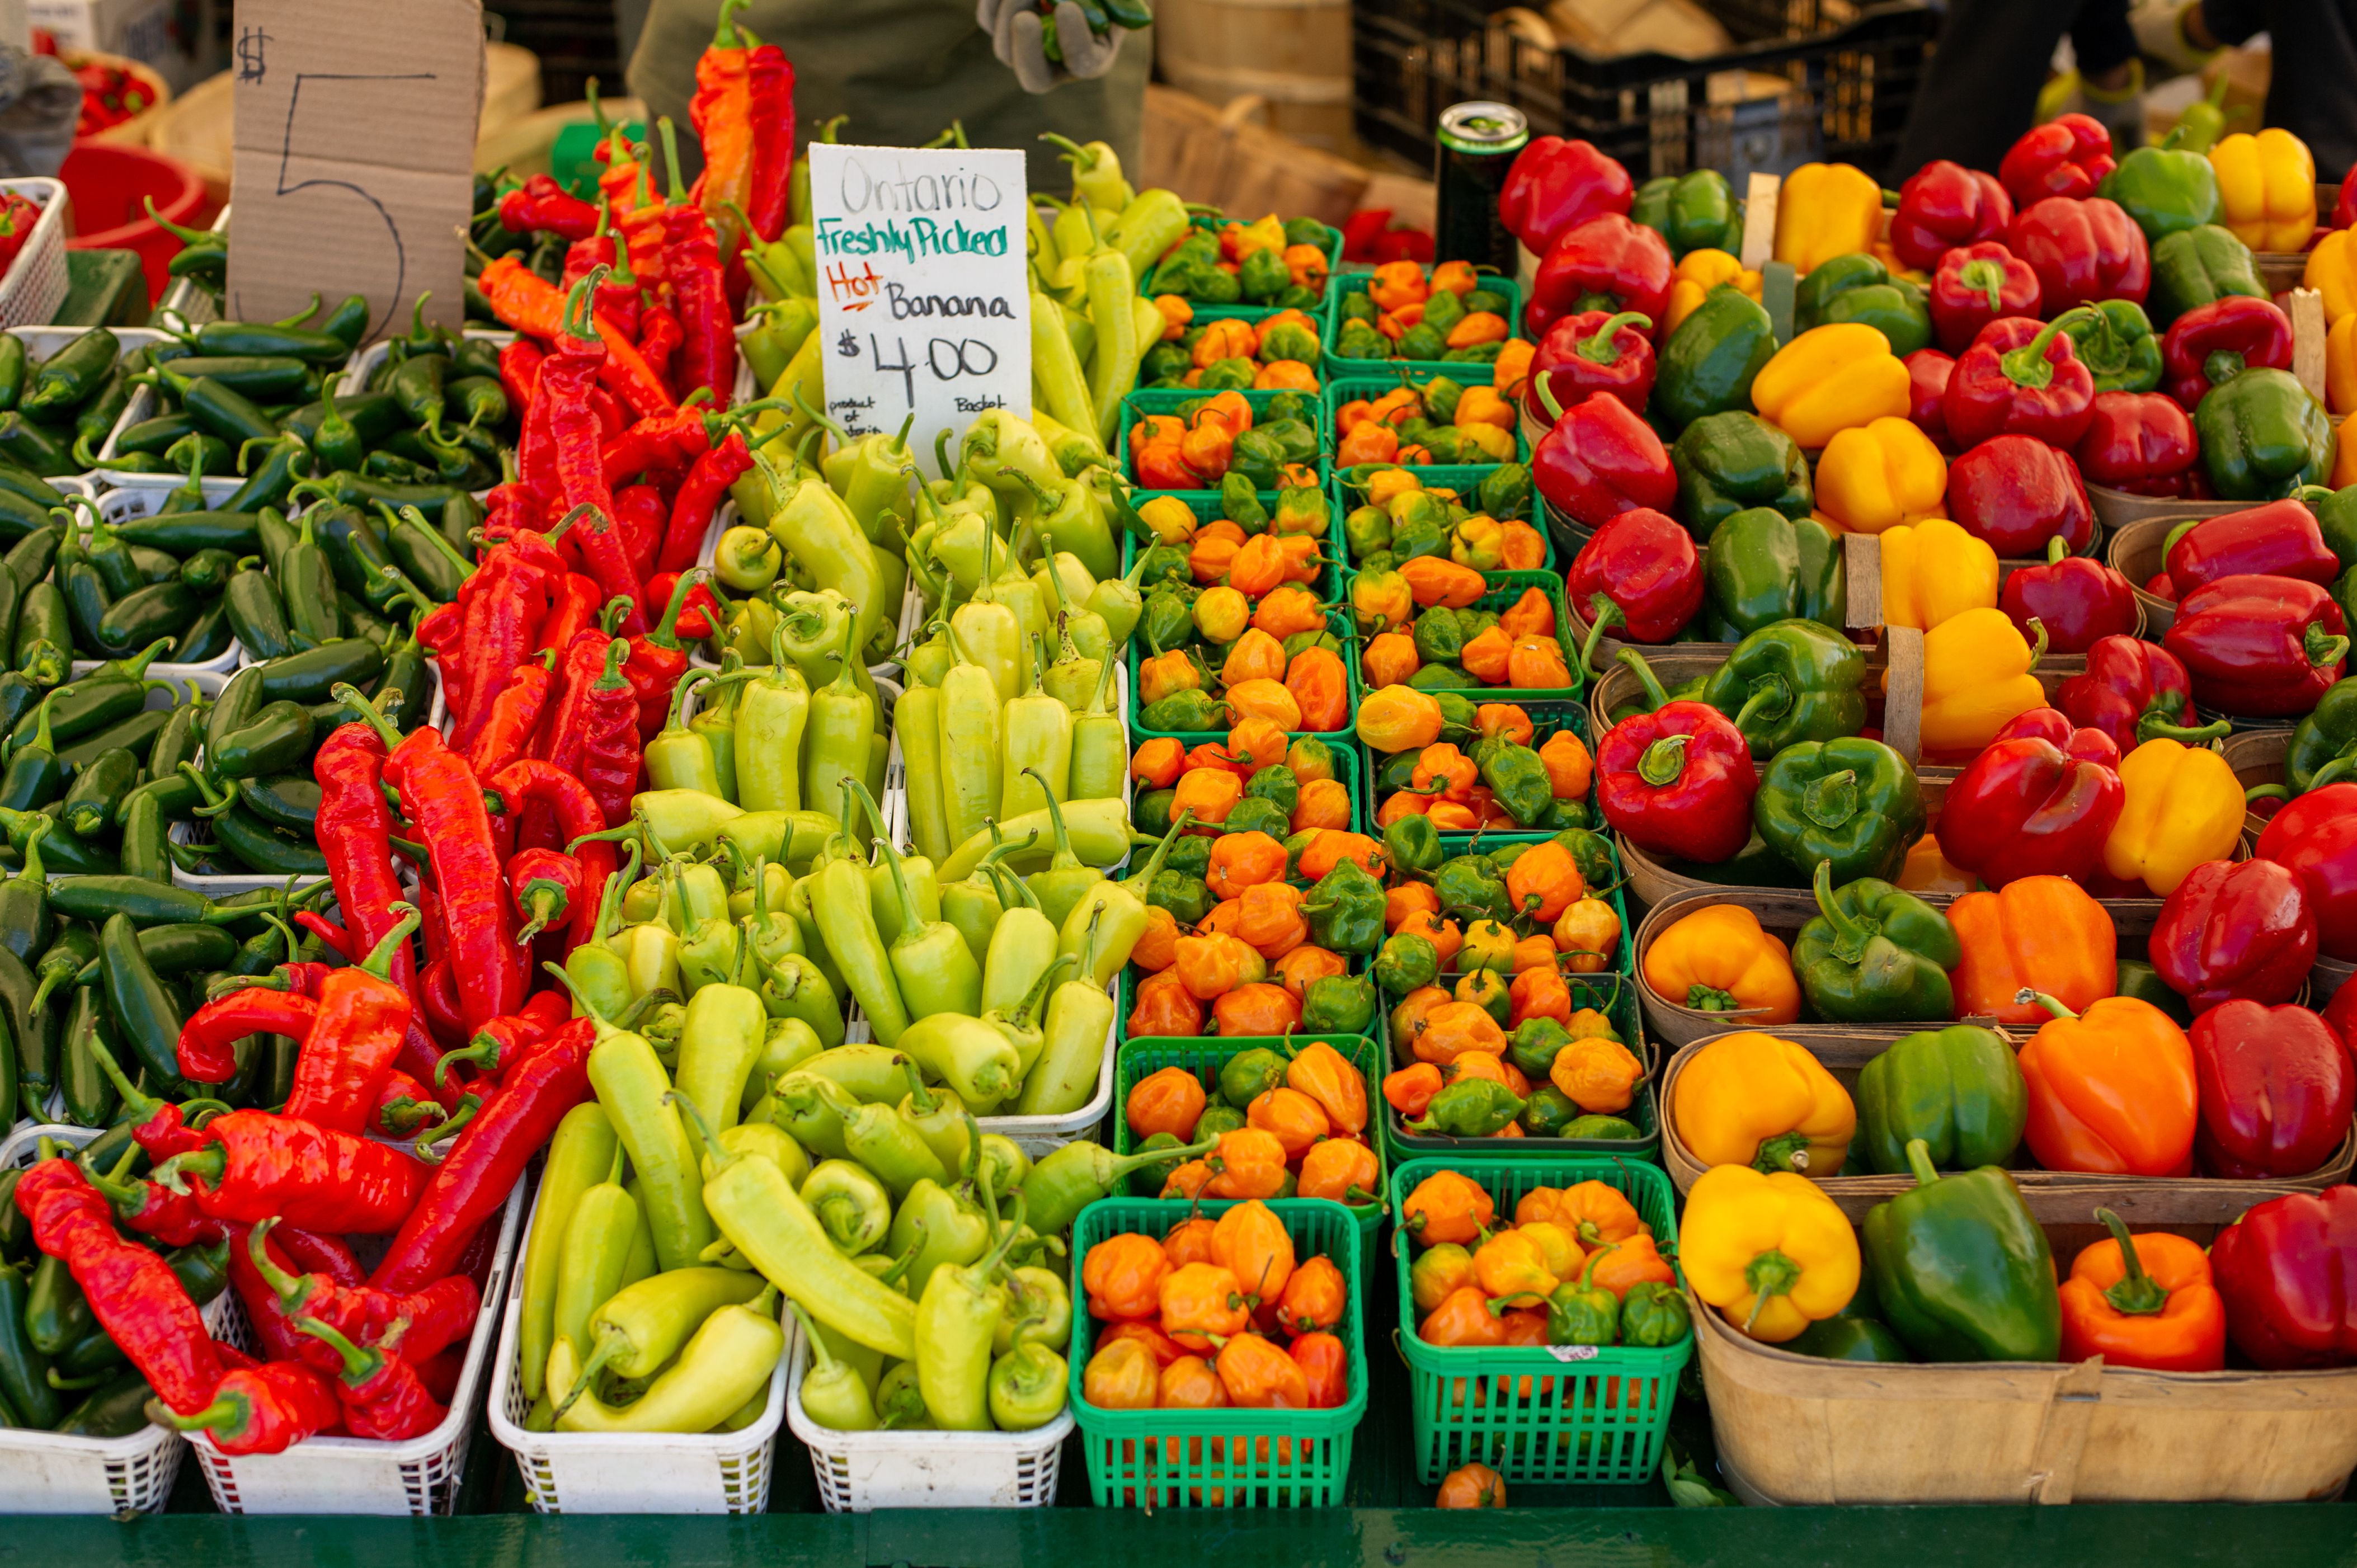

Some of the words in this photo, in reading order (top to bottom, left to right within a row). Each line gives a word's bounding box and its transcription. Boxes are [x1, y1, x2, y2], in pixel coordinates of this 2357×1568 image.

[841, 157, 1003, 215] Ontario
[817, 218, 915, 265] Freshly
[909, 217, 1008, 257] Picked
[826, 261, 883, 302] Hot
[885, 281, 1017, 321] Banana
[829, 395, 876, 415] product
[844, 409, 860, 422] of
[954, 394, 1007, 413] Basket
